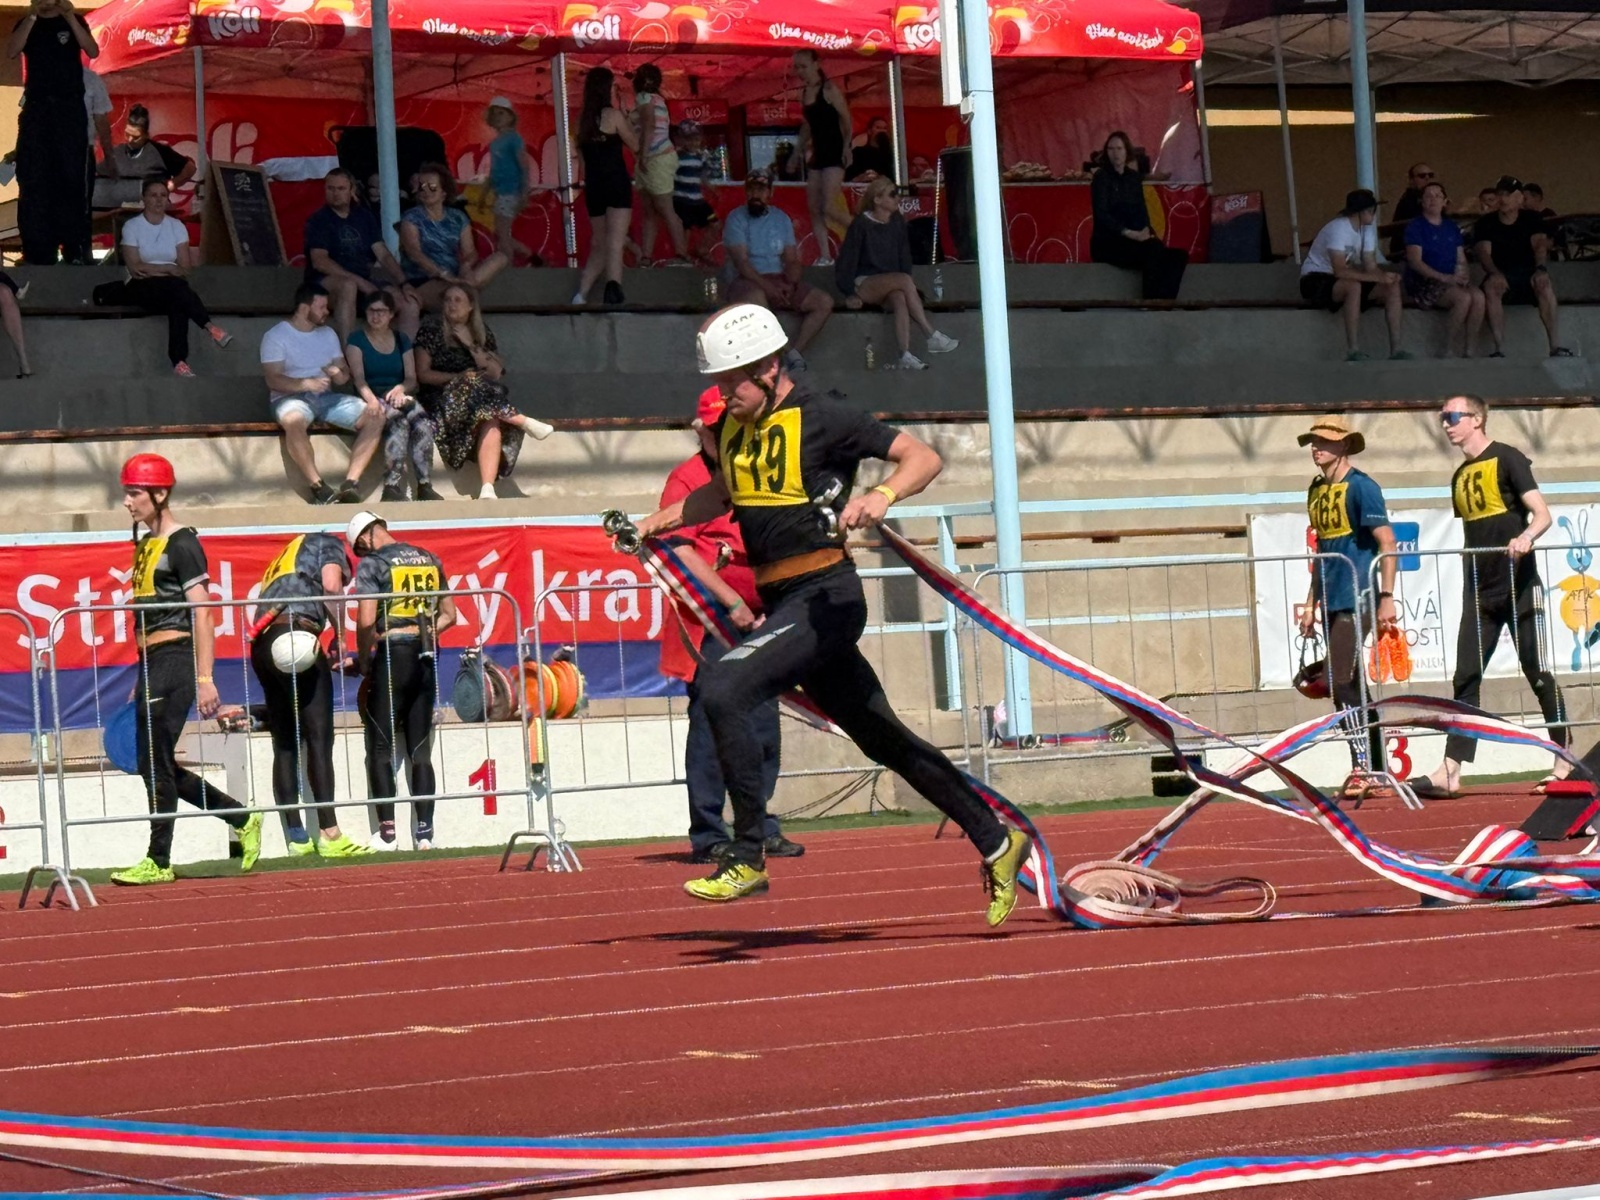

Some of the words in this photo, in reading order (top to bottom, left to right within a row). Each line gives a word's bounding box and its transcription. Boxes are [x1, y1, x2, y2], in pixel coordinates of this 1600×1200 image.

[723, 312, 756, 331] CAMP
[725, 423, 787, 494] 119
[1462, 470, 1487, 514] 15
[531, 548, 664, 640] kraj
[1385, 736, 1413, 782] 3
[468, 759, 497, 816] 1
